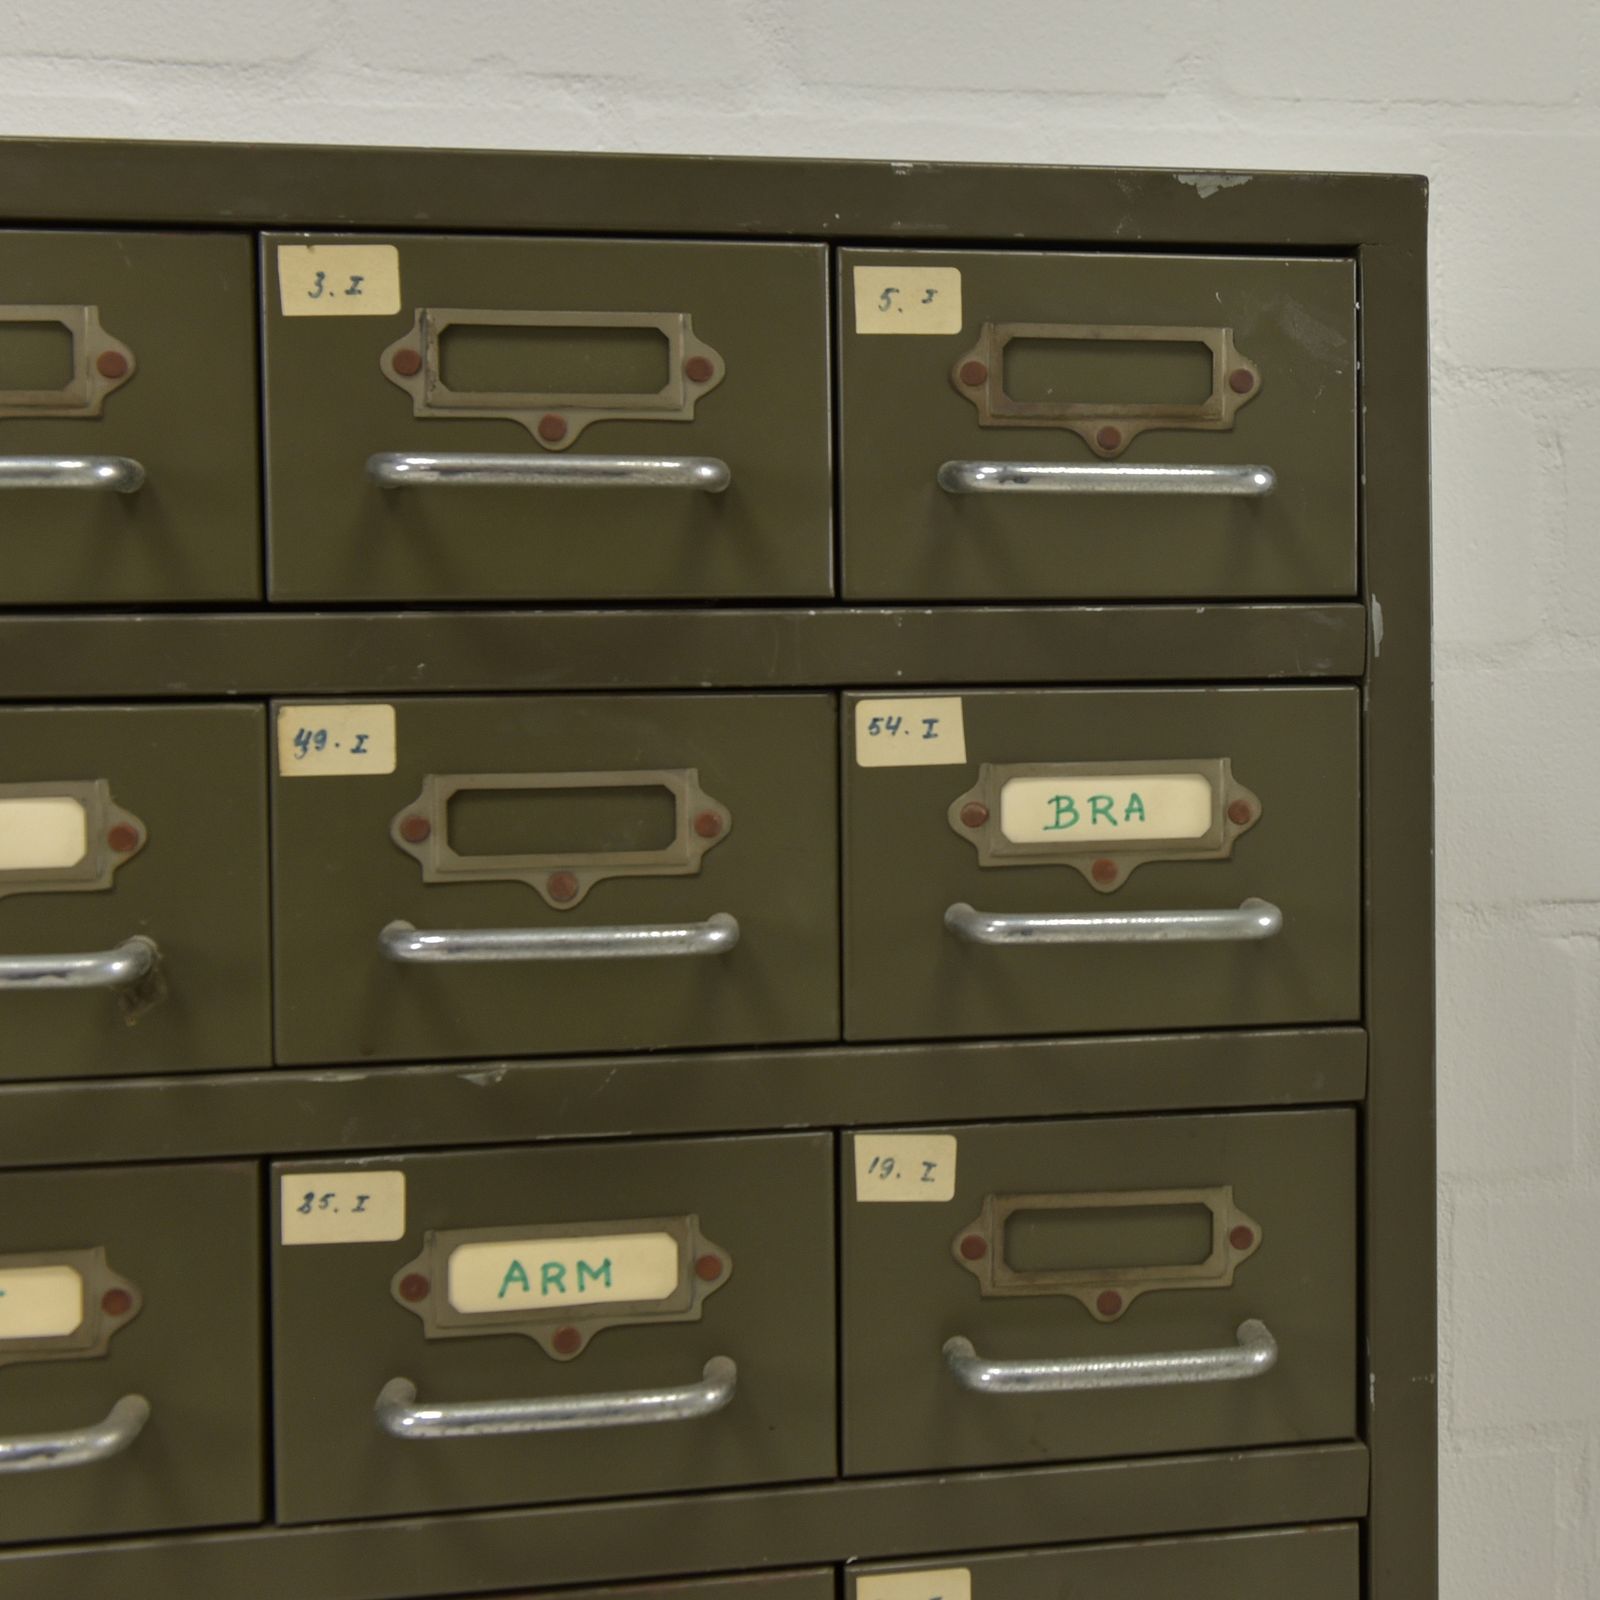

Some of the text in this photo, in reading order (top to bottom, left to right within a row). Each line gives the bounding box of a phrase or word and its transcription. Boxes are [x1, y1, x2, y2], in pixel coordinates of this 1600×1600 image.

[306, 270, 335, 300] 3.
[877, 286, 904, 314] 5.
[866, 714, 941, 741] 54. I
[292, 726, 371, 761] 49. I
[1041, 791, 1147, 832] BRA
[867, 1155, 903, 1181] 19.
[350, 1193, 372, 1214] I
[497, 1257, 614, 1299] ARM
